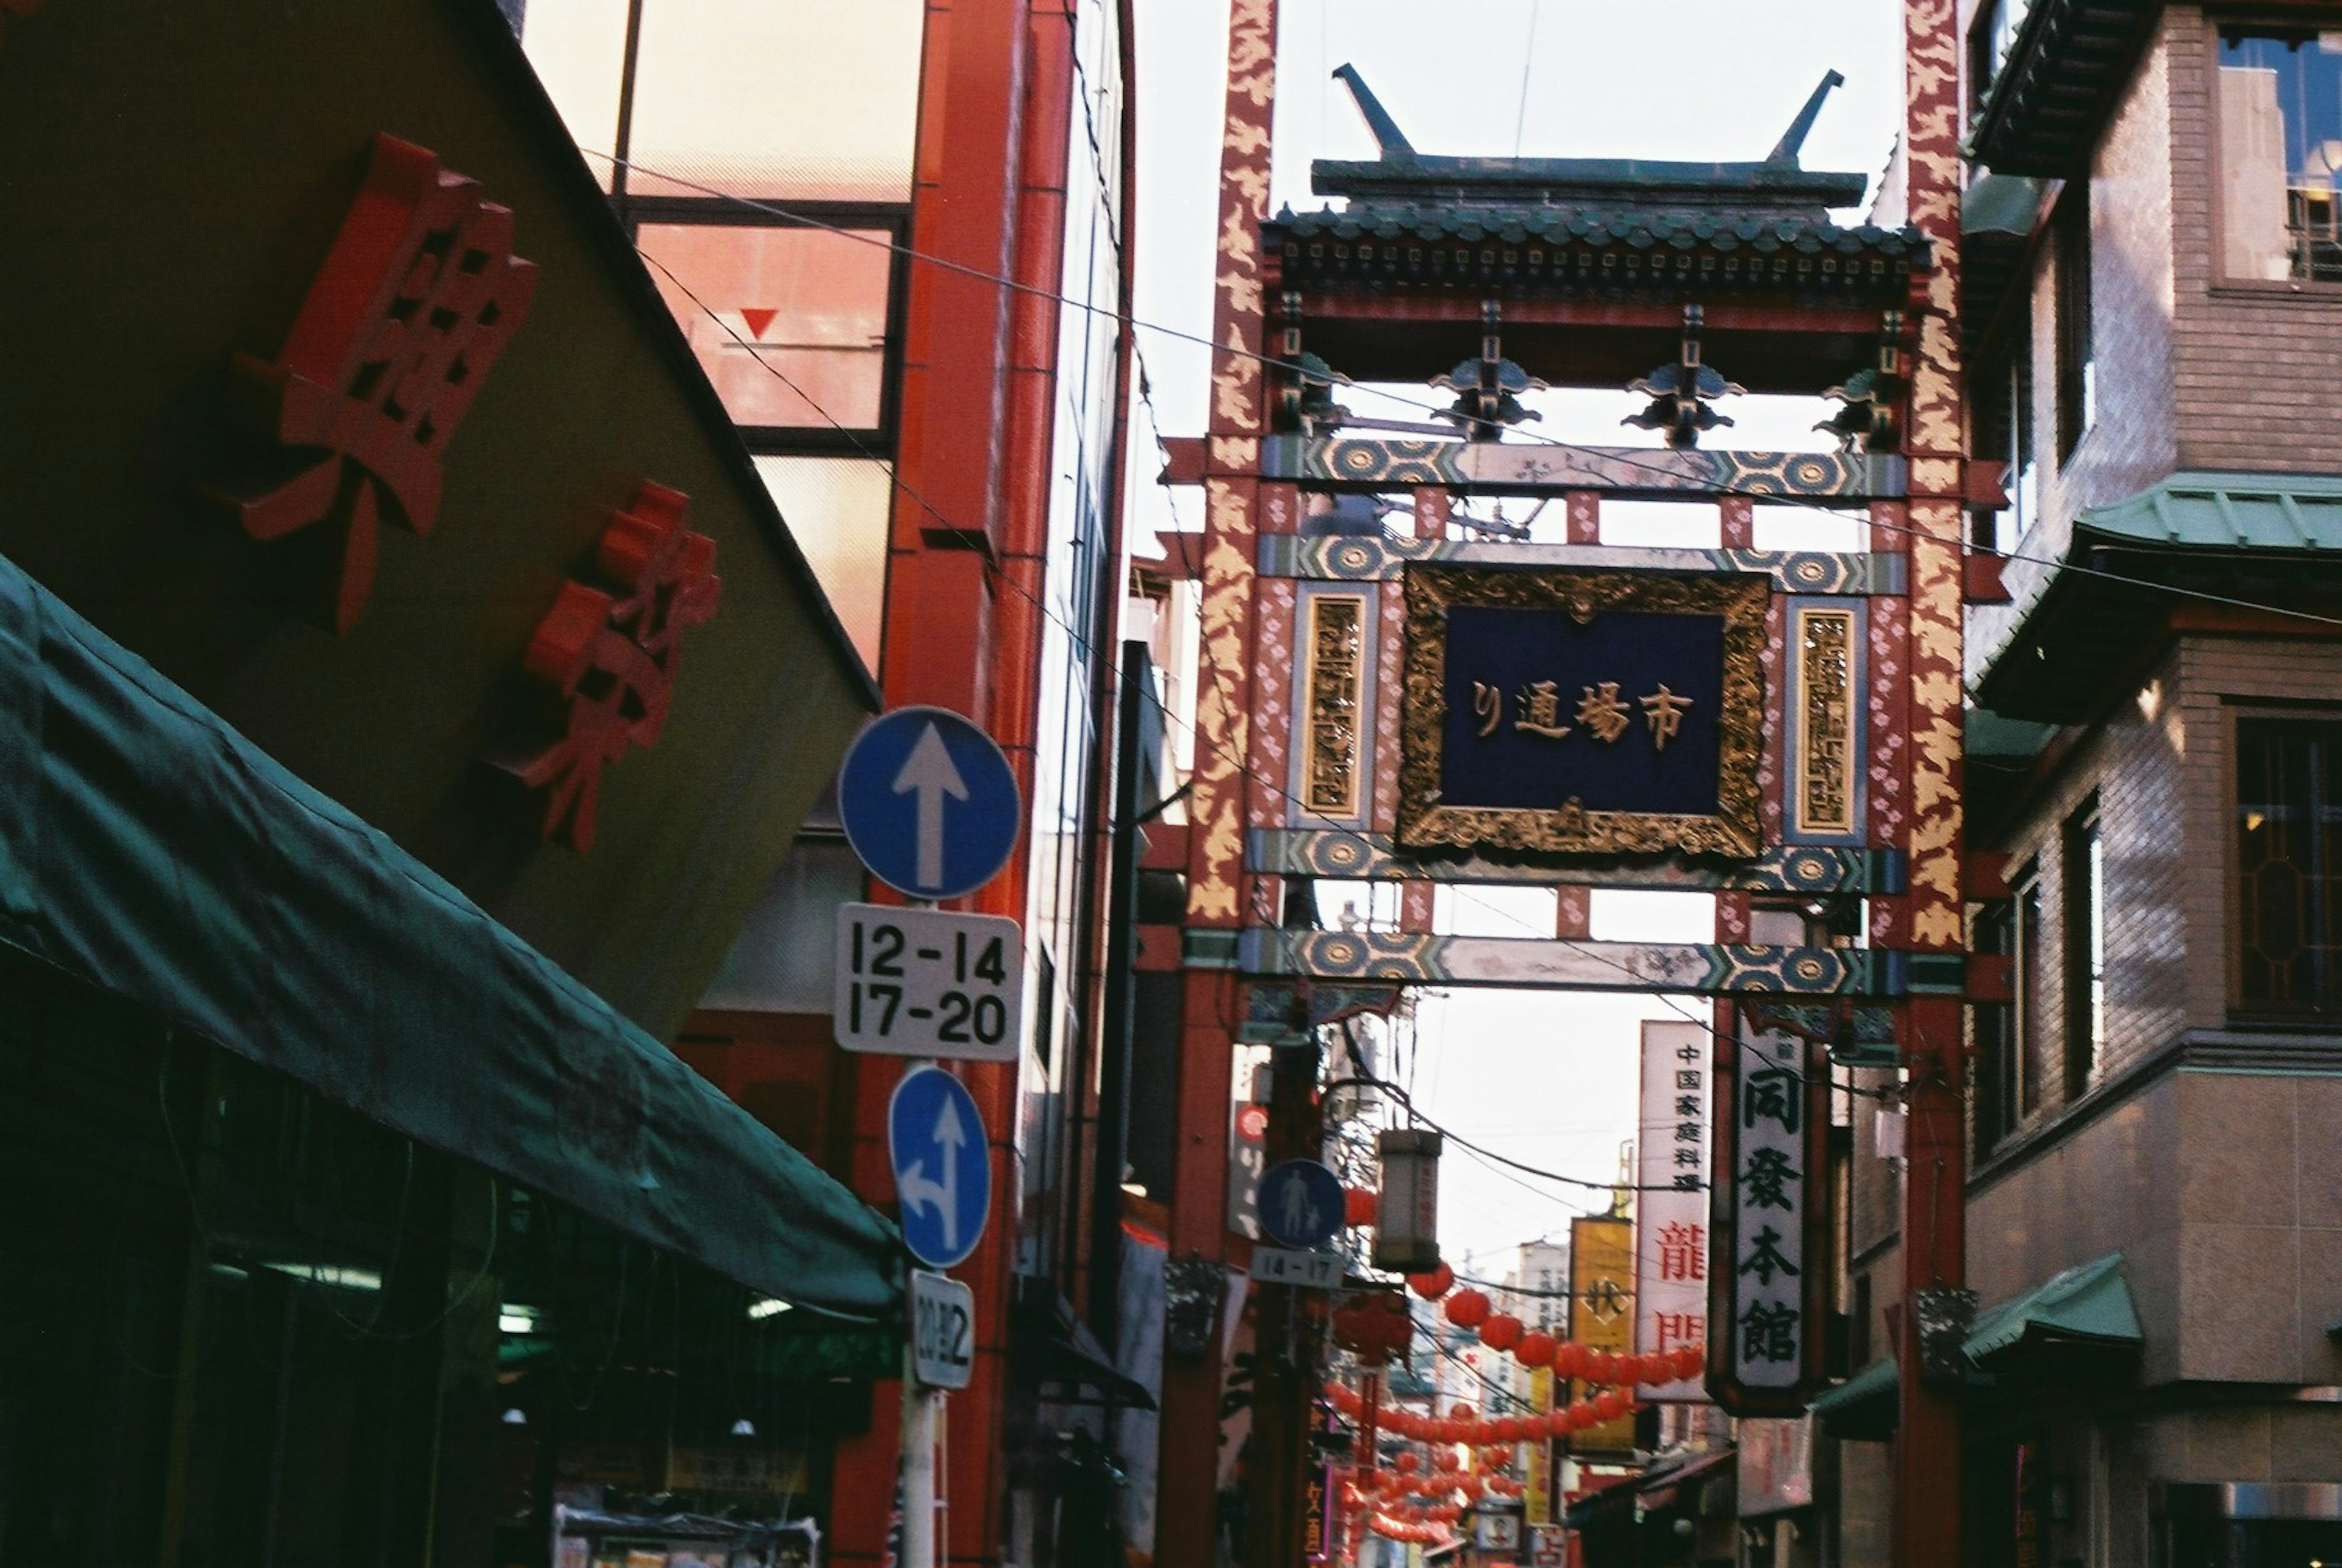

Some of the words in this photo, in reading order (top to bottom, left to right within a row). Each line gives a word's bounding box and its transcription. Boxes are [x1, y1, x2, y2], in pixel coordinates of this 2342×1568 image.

[1471, 679, 1695, 751] 市場通り
[851, 921, 1006, 986] 12-14
[850, 981, 1008, 1045] 17-20
